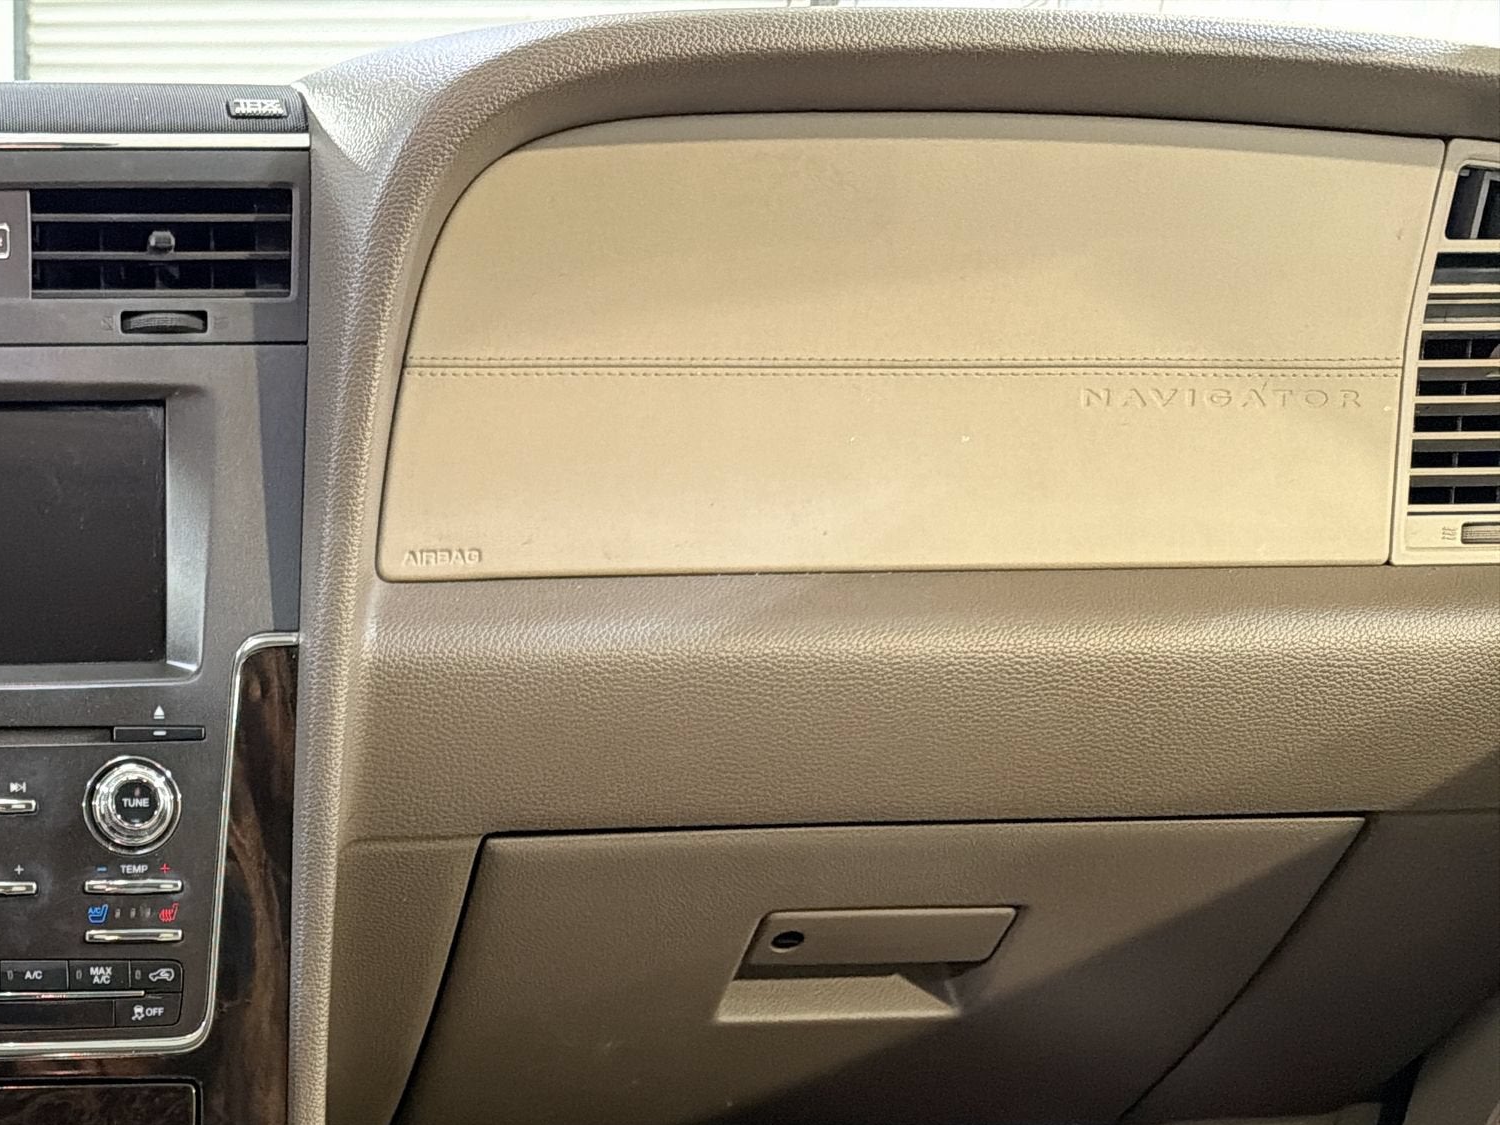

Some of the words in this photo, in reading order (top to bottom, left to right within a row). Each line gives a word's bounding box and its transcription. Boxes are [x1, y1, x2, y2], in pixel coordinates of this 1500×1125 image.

[1079, 386, 1362, 408] NAVIGATOR
[402, 548, 483, 567] AIRBAG
[122, 798, 150, 808] TUNE
[120, 864, 149, 874] TEMP
[24, 970, 44, 980] A/C
[89, 967, 113, 976] MAX
[92, 975, 112, 985] A/C
[145, 1006, 165, 1017] OFF
